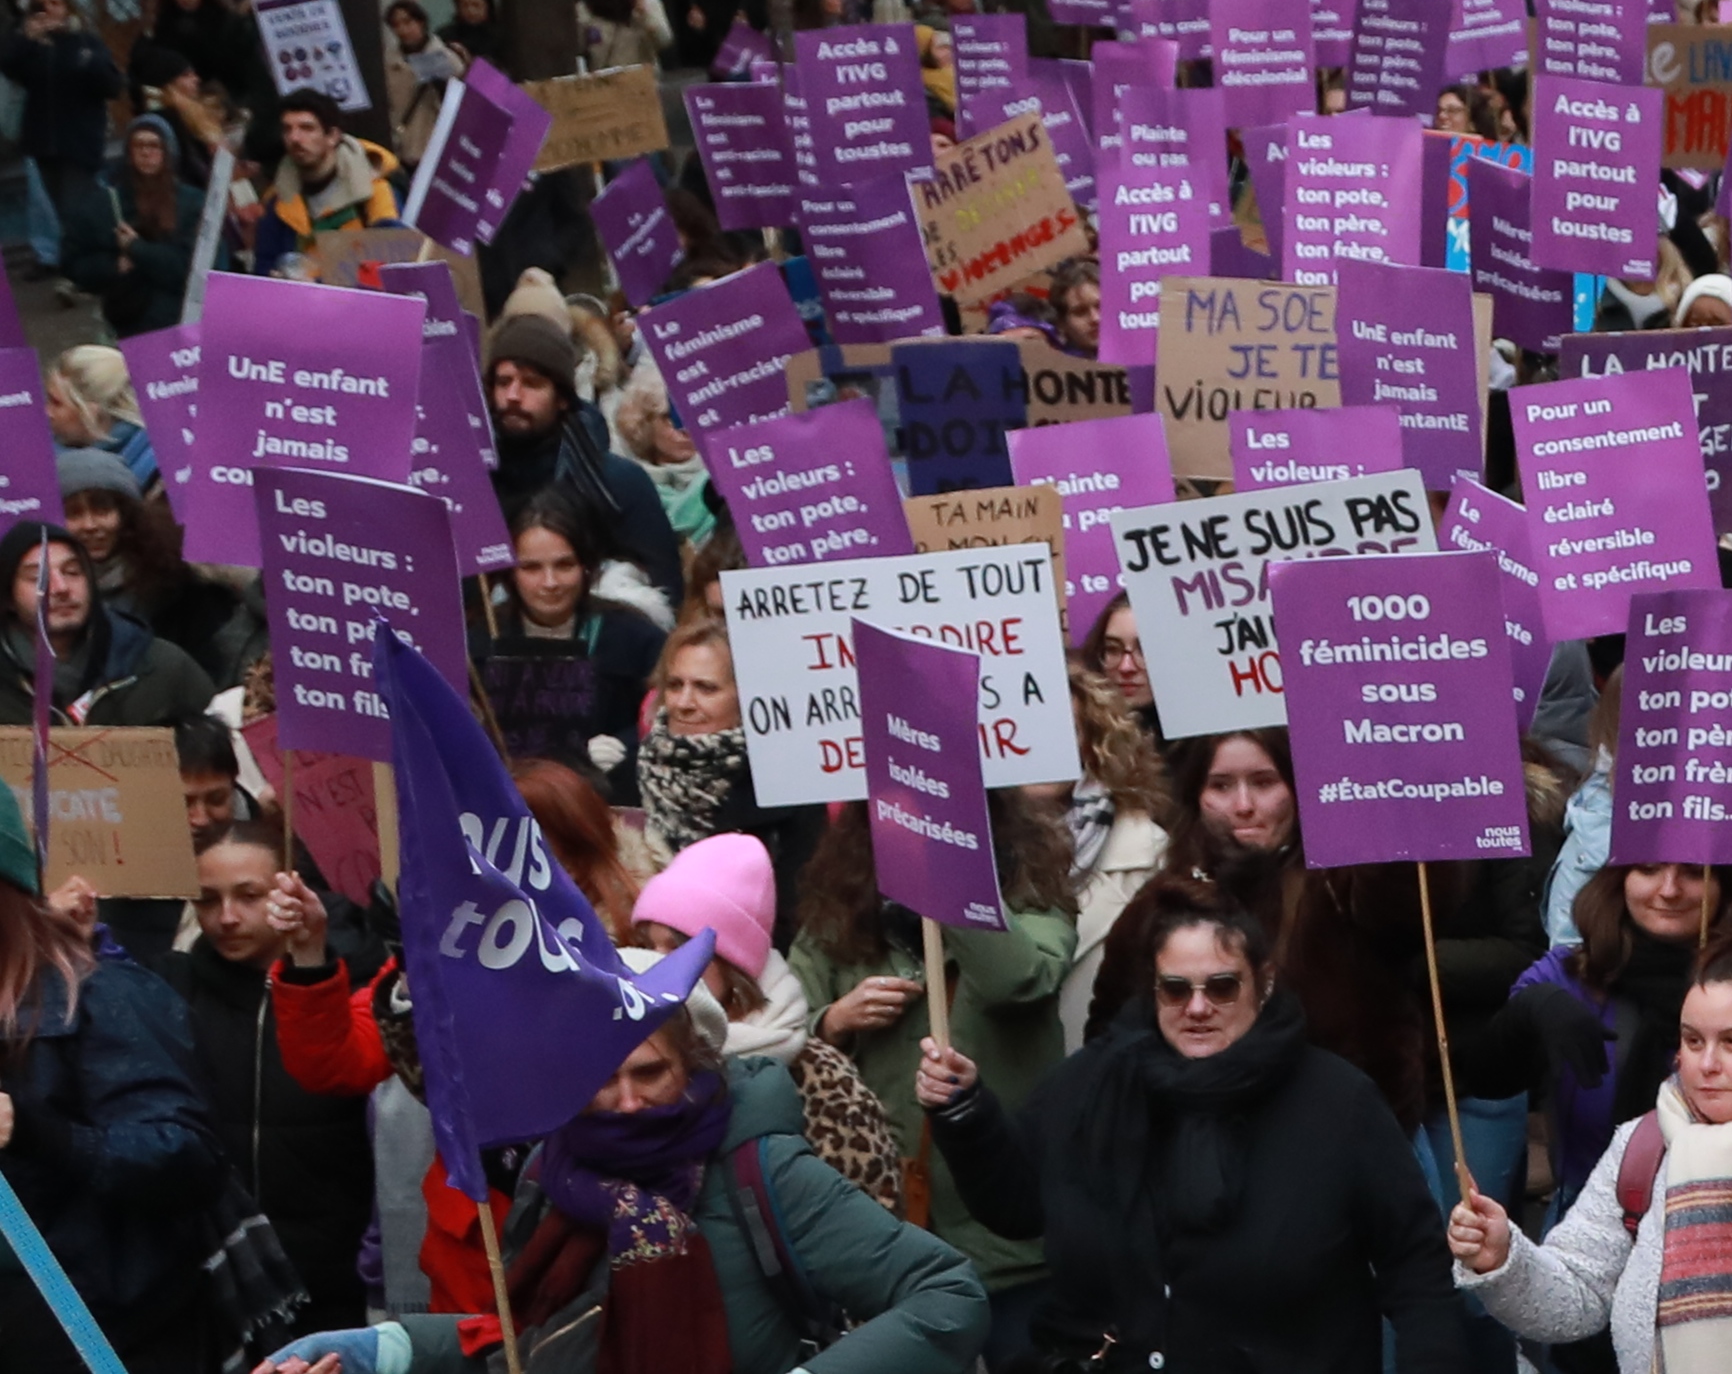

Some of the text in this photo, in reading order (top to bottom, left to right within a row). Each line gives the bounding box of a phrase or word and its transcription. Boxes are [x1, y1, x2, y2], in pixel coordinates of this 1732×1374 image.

[1229, 29, 1295, 43] Pour un
[1221, 48, 1305, 64] féminisme
[1222, 67, 1307, 85] décolonial
[1555, 95, 1640, 122] Accès à
[1554, 160, 1636, 183] partout
[1567, 192, 1619, 211] pour
[1552, 217, 1632, 243] toustes
[1186, 288, 1241, 336] MA
[1227, 343, 1339, 380] JE TE
[1002, 365, 1131, 405] HONTE
[930, 502, 968, 527] TA
[1244, 500, 1335, 555] SUIS
[1345, 490, 1420, 537] PAS
[736, 559, 1045, 620] ARRETEZ DE TOUT
[1348, 595, 1429, 620] 1000
[1300, 634, 1487, 665] féminicides
[1022, 671, 1045, 707] A
[1362, 684, 1436, 702] sous
[750, 697, 792, 735] ON
[1344, 719, 1464, 743] Macron
[1319, 776, 1503, 803] #ÉtatCoupable
[1476, 836, 1522, 851] toutes
[1485, 826, 1521, 839] nous
